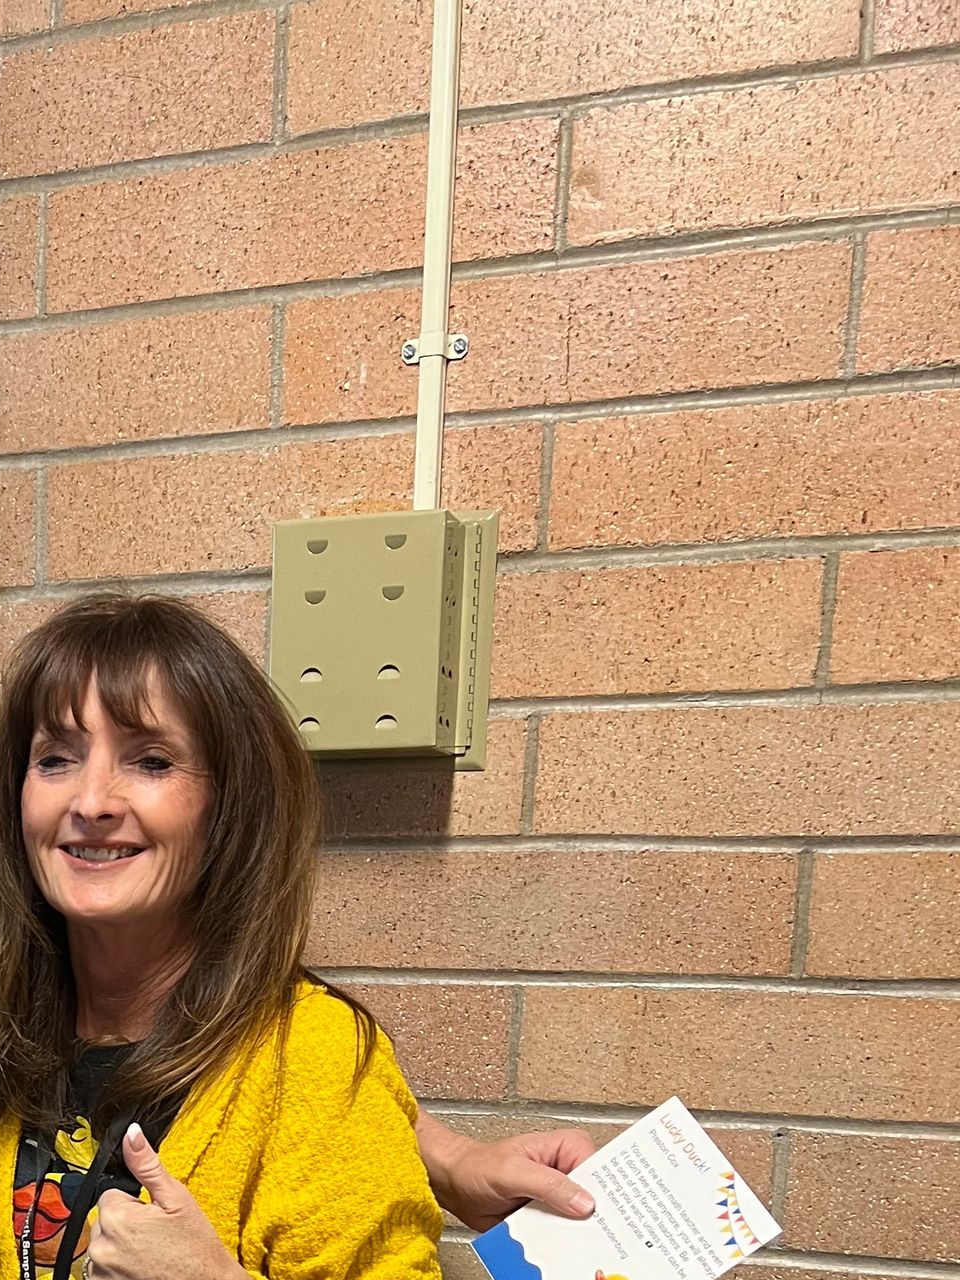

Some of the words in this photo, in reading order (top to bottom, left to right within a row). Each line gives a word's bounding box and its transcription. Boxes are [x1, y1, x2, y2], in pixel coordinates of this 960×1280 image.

[648, 1128, 670, 1155] Preston
[666, 1153, 679, 1169] Cox
[659, 1113, 687, 1145] Lucky
[682, 1142, 711, 1173] Duck!
[601, 1165, 624, 1193] anything
[618, 1190, 633, 1205] you
[656, 1242, 671, 1257] you
[606, 1190, 621, 1207] then
[616, 1166, 629, 1181] one
[631, 1186, 643, 1199] my
[639, 1196, 660, 1223] favorite
[678, 1250, 690, 1263] Be
[630, 1142, 643, 1158] You
[639, 1157, 651, 1169] are
[647, 1167, 659, 1180] the
[655, 1178, 671, 1195] best
[666, 1193, 682, 1212] math
[679, 1209, 701, 1236] teacher
[697, 1235, 712, 1250] and
[707, 1249, 724, 1268] even
[637, 1175, 650, 1189] see
[645, 1187, 660, 1201] you
[677, 1230, 691, 1245] you
[688, 1243, 702, 1256] will
[696, 1255, 717, 1280] always
[596, 1217, 629, 1260] Brandenburg
